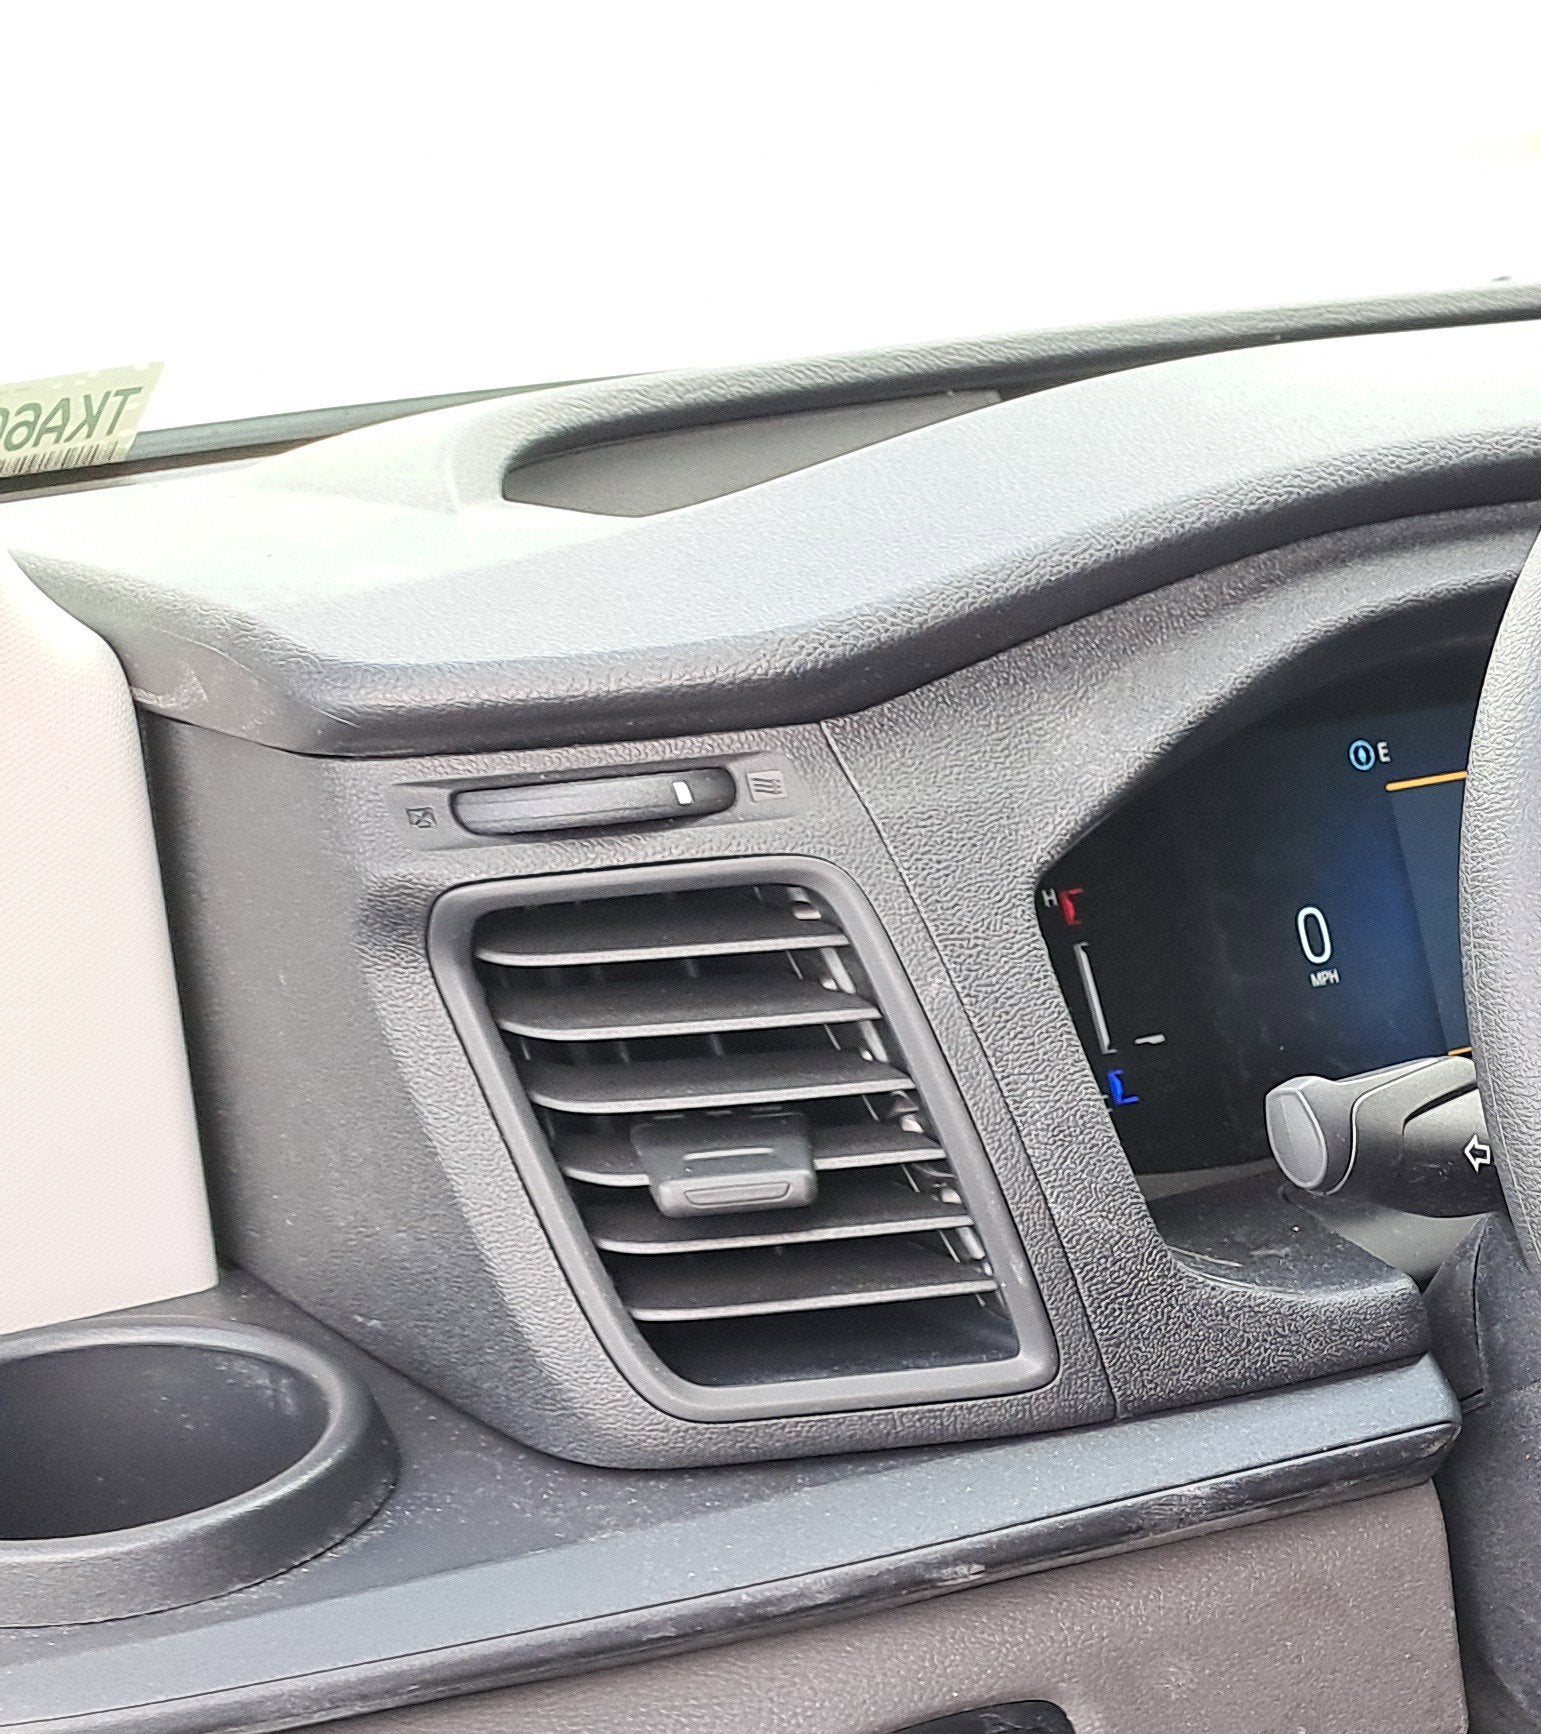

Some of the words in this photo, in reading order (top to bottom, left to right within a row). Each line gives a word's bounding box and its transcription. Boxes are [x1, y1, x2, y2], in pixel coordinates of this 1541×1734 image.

[1376, 741, 1391, 763] E
[1041, 887, 1059, 908] H
[1297, 906, 1332, 964] 0
[1309, 968, 1340, 988] MPH
